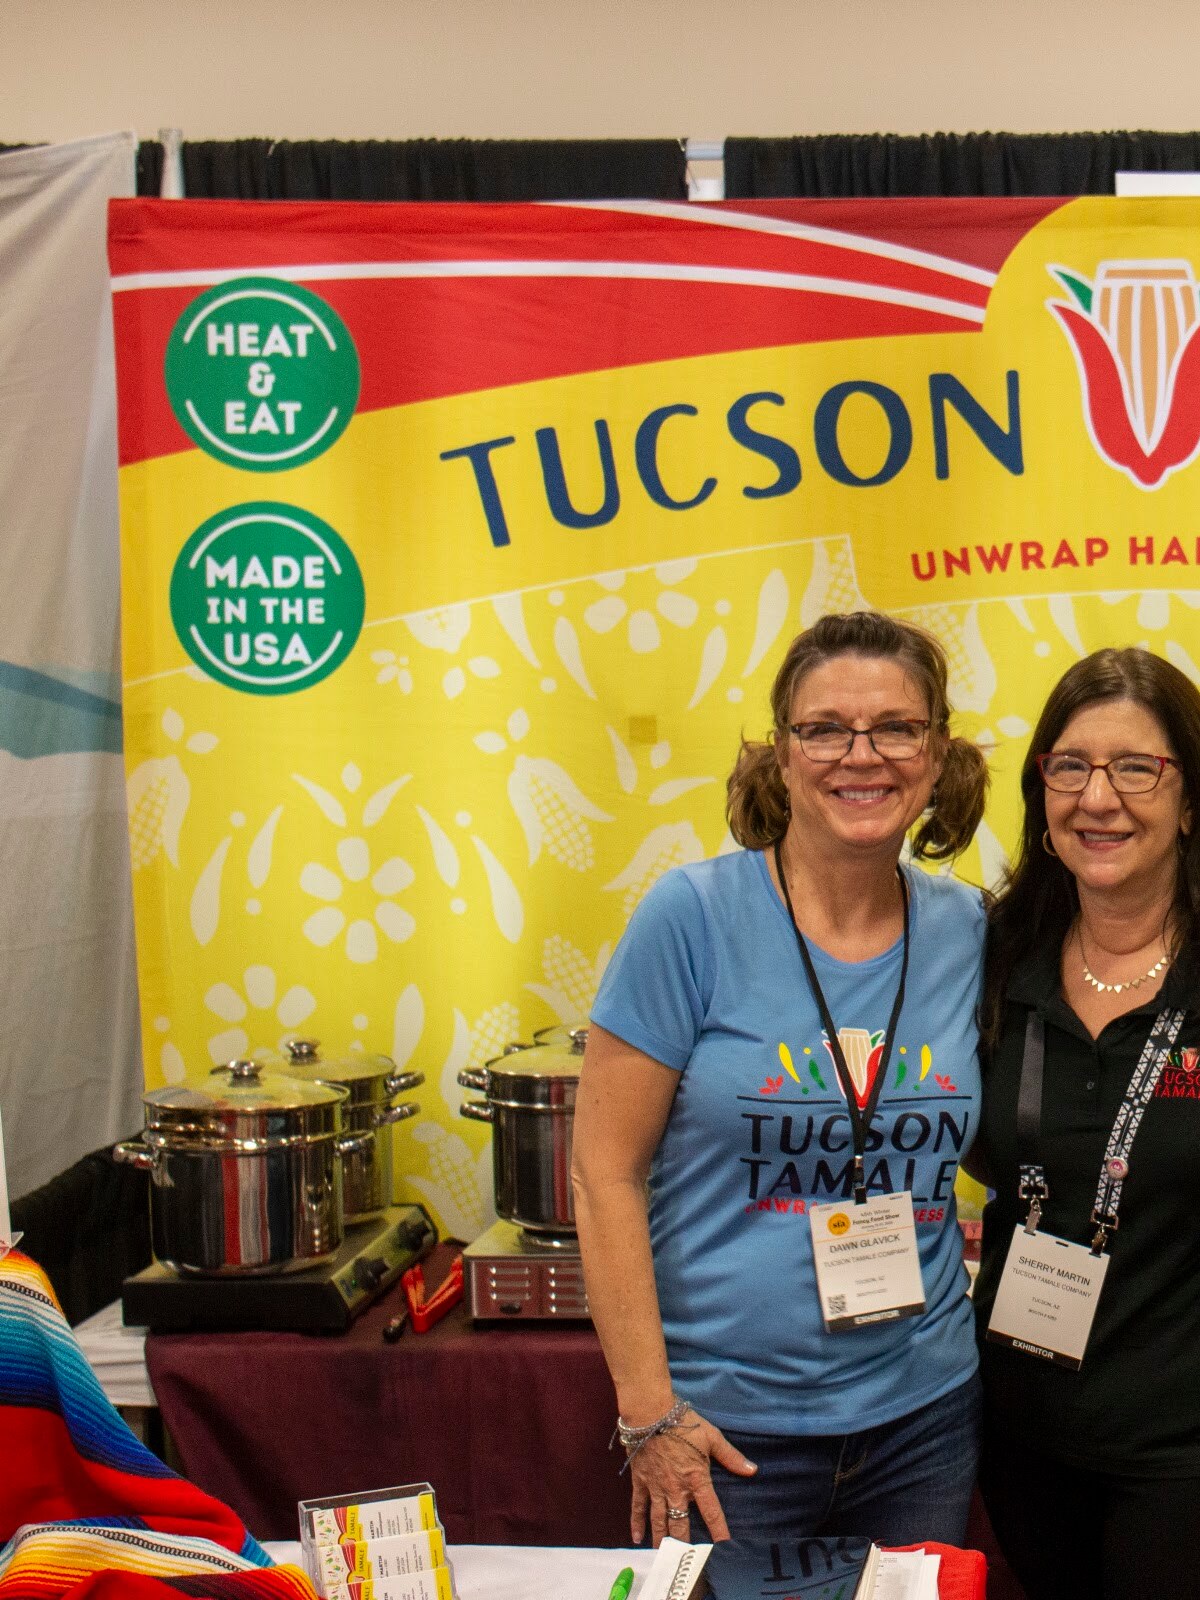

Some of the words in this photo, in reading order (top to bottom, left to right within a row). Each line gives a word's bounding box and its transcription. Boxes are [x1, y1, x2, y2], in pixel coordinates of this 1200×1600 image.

[206, 323, 313, 357] HEAT
[247, 362, 275, 396] &
[224, 401, 302, 435] EAT
[440, 369, 1025, 548] TUCSON
[206, 556, 326, 589] MADE
[911, 536, 1110, 582] UNWRAP
[206, 598, 250, 624] IN
[260, 598, 325, 624] THE
[224, 633, 312, 667] USA
[884, 1213, 900, 1221] Show
[824, 1258, 851, 1269] TUCSON
[877, 1247, 910, 1259] COMPANY
[829, 1241, 859, 1254] DAWN
[860, 1233, 901, 1248] GLAVICK
[1012, 1267, 1038, 1282] TUCSON
[1038, 1275, 1061, 1289] TAMALE
[1061, 1283, 1092, 1299] COMPANY
[1018, 1256, 1056, 1274] SHERRY
[1056, 1268, 1091, 1286] MARTIN
[1012, 1339, 1054, 1360] EXHIBITOR
